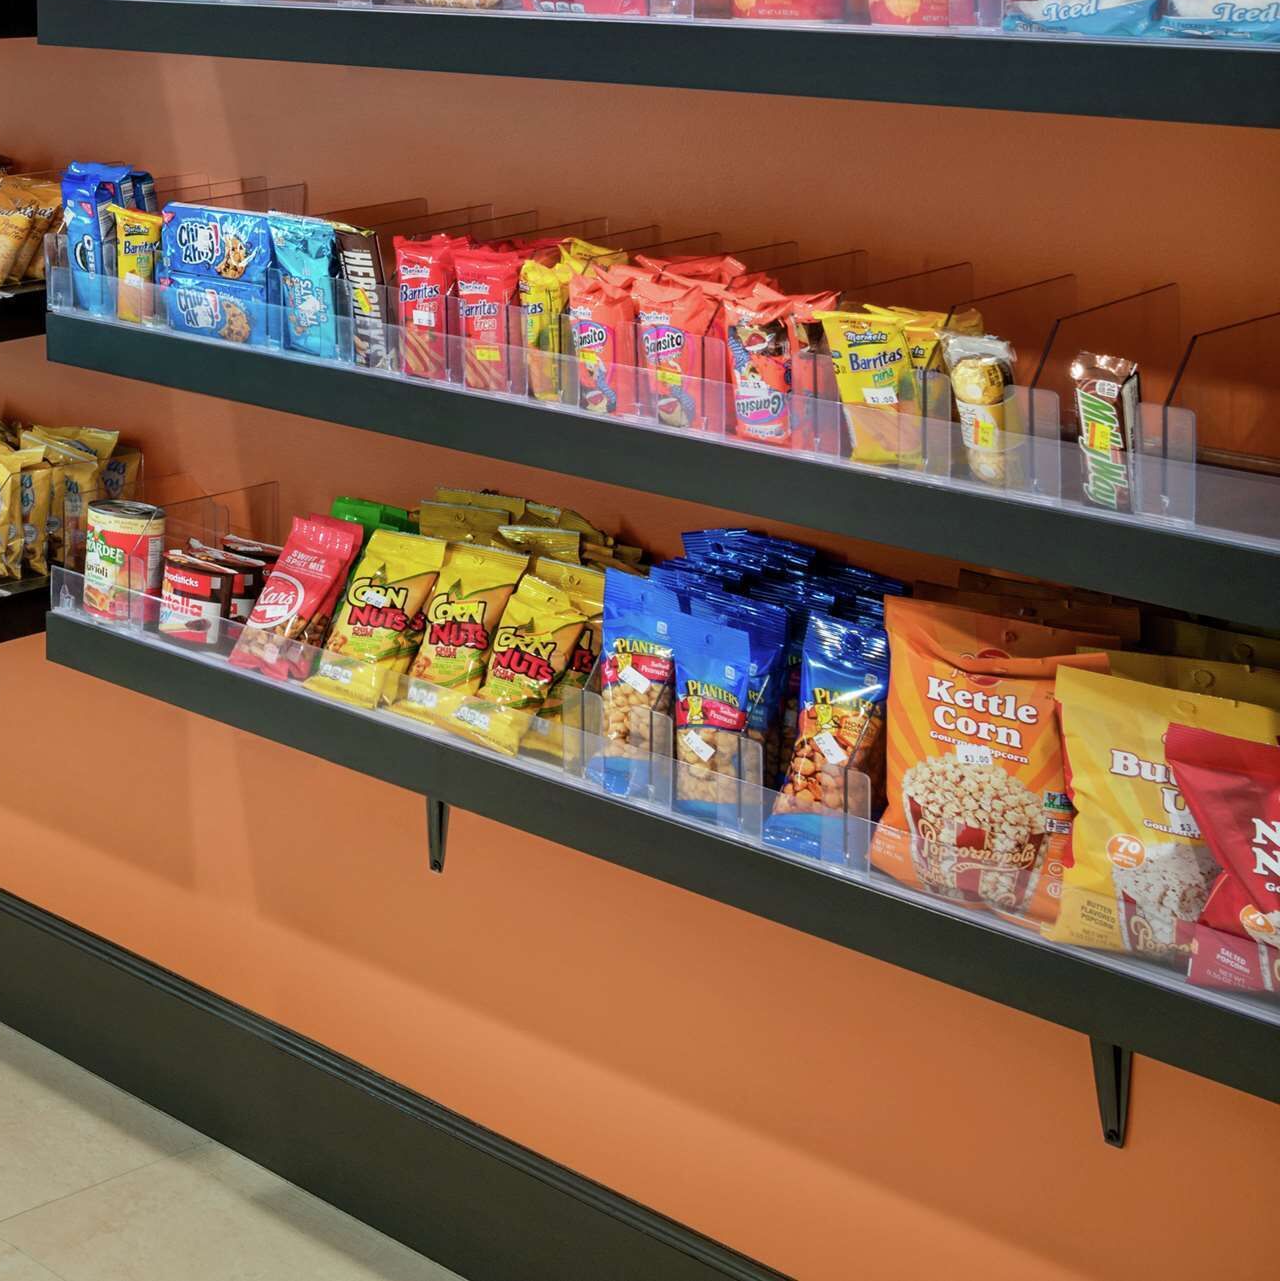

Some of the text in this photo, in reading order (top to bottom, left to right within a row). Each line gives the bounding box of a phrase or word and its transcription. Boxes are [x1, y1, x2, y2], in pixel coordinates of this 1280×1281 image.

[1214, 3, 1280, 23] Iced
[124, 240, 161, 255] Barritas
[83, 236, 95, 280] OREO
[402, 267, 430, 278] Marinela
[400, 283, 439, 302] Barritas
[459, 301, 499, 317] Barritas
[573, 328, 605, 351] Gansito
[644, 333, 684, 358] Gansito
[845, 331, 888, 341] Marinela
[849, 348, 903, 371] Barritas
[309, 562, 326, 573] MIX
[257, 586, 296, 607] Kar's
[347, 577, 409, 610] CORN
[347, 605, 408, 632] NUTS
[430, 621, 489, 651] NUTS
[616, 637, 674, 660] PLANTERS
[493, 650, 555, 684] NUTS
[640, 665, 670, 678] Peanuts
[650, 660, 671, 671] Salted
[687, 679, 740, 707] PLANTERS
[926, 675, 1039, 725] Kettle
[709, 709, 738, 726] Peanuts
[718, 706, 739, 718] Salted
[933, 705, 1022, 750] Corn
[964, 753, 991, 765] $3.00
[917, 818, 1037, 869] Popcornopolis
[1115, 837, 1141, 854] 70
[1080, 905, 1116, 924] FLAVORED
[1086, 899, 1113, 915] BUTTER
[1216, 953, 1251, 974] POPCORN
[1220, 947, 1247, 966] SALTED
